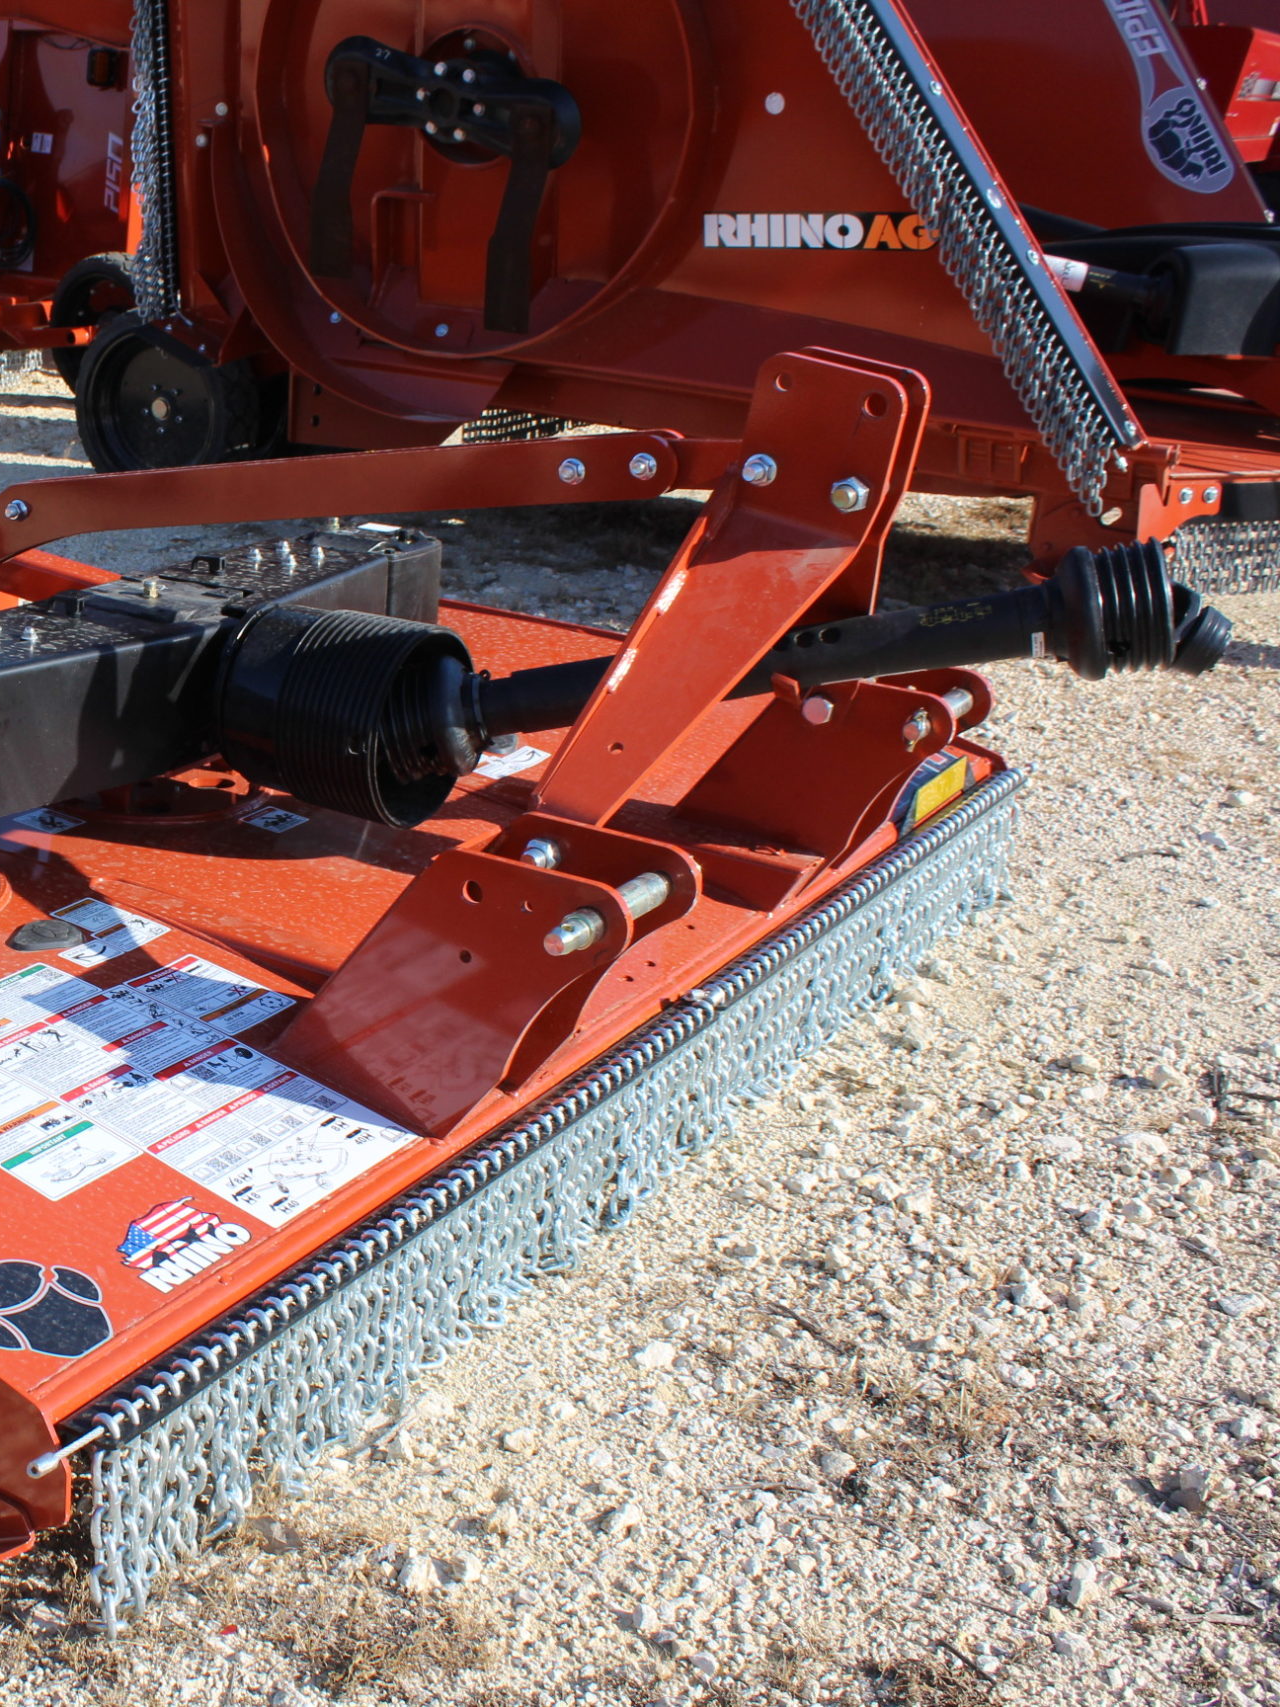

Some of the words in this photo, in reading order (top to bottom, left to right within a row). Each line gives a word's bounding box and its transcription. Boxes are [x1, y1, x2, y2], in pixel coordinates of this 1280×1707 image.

[64, 1000, 94, 1014] DANGER
[1, 1029, 32, 1043] DANGER
[126, 1027, 153, 1040] DANGER
[186, 1050, 214, 1064] DANGER
[87, 1072, 116, 1087] DANGER
[0, 1113, 35, 1131] WARNING
[159, 1128, 192, 1146] PELIGRO
[199, 1109, 228, 1124] DANGER
[230, 1092, 259, 1107] PERIGO
[27, 1133, 68, 1155] IMPORTANT
[138, 1222, 252, 1294] RHINO
